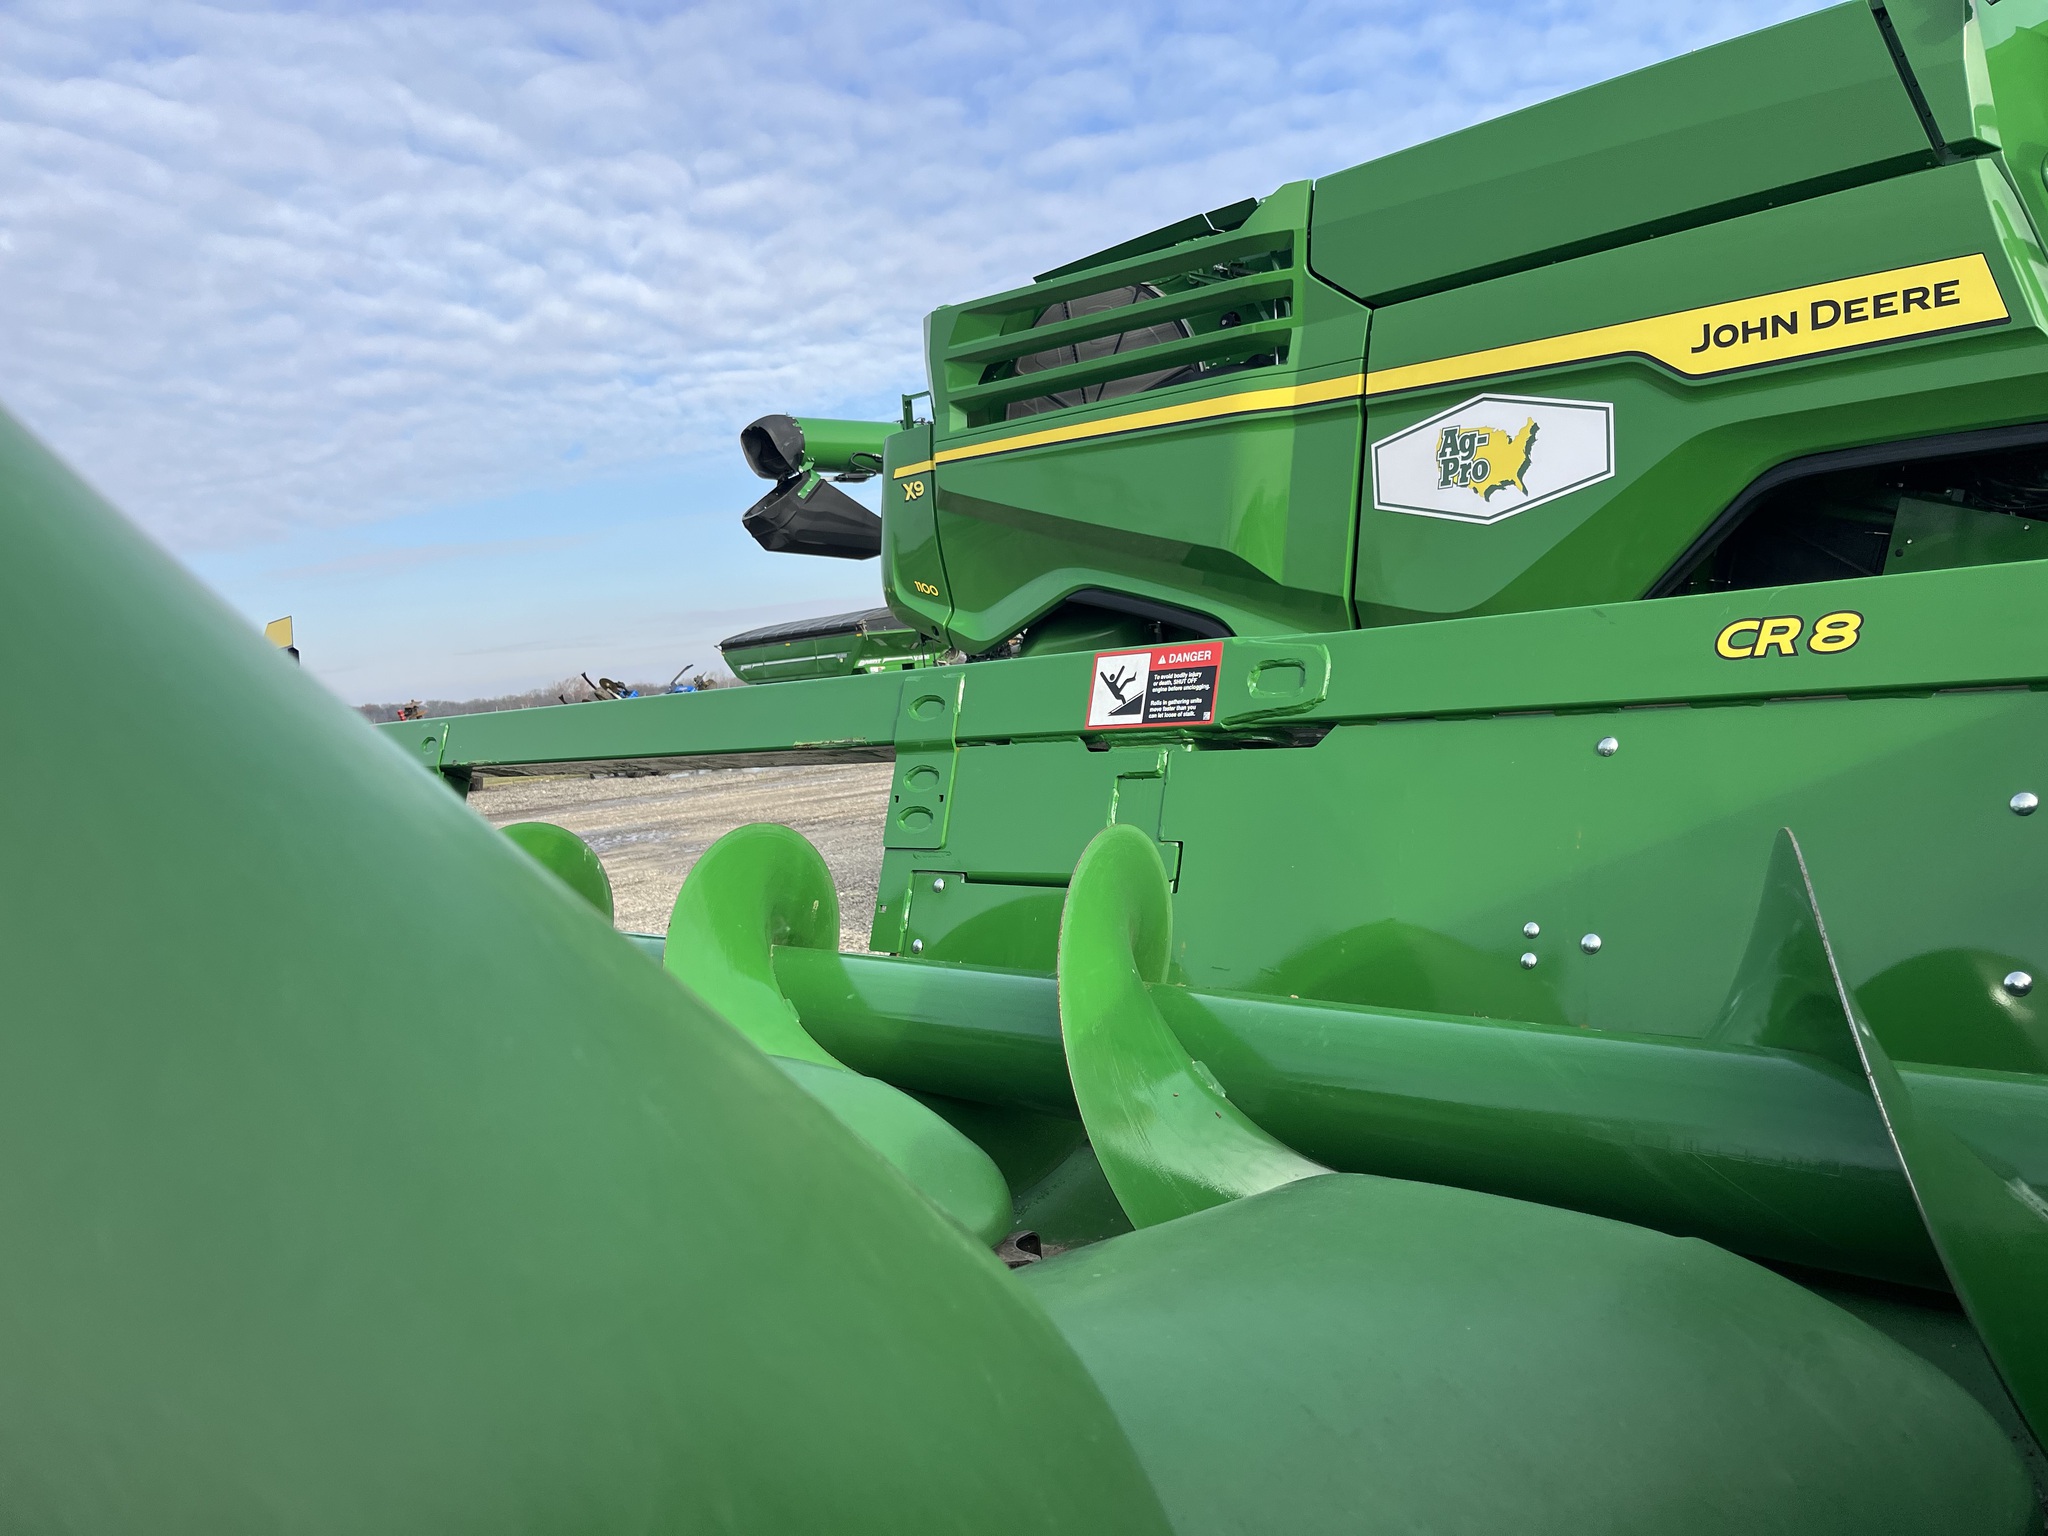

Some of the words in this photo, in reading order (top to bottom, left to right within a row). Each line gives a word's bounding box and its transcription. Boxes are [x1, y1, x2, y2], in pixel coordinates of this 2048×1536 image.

[1691, 311, 1798, 354] JOHN
[1811, 279, 1960, 331] DEERE
[1439, 426, 1489, 461] Ag-
[1438, 457, 1490, 490] Pro
[902, 481, 925, 502] X9
[914, 580, 939, 597] 1100
[1168, 650, 1211, 664] DANGER
[1174, 672, 1188, 680] bodily
[1188, 671, 1202, 679] injury
[1168, 698, 1189, 706] gathering
